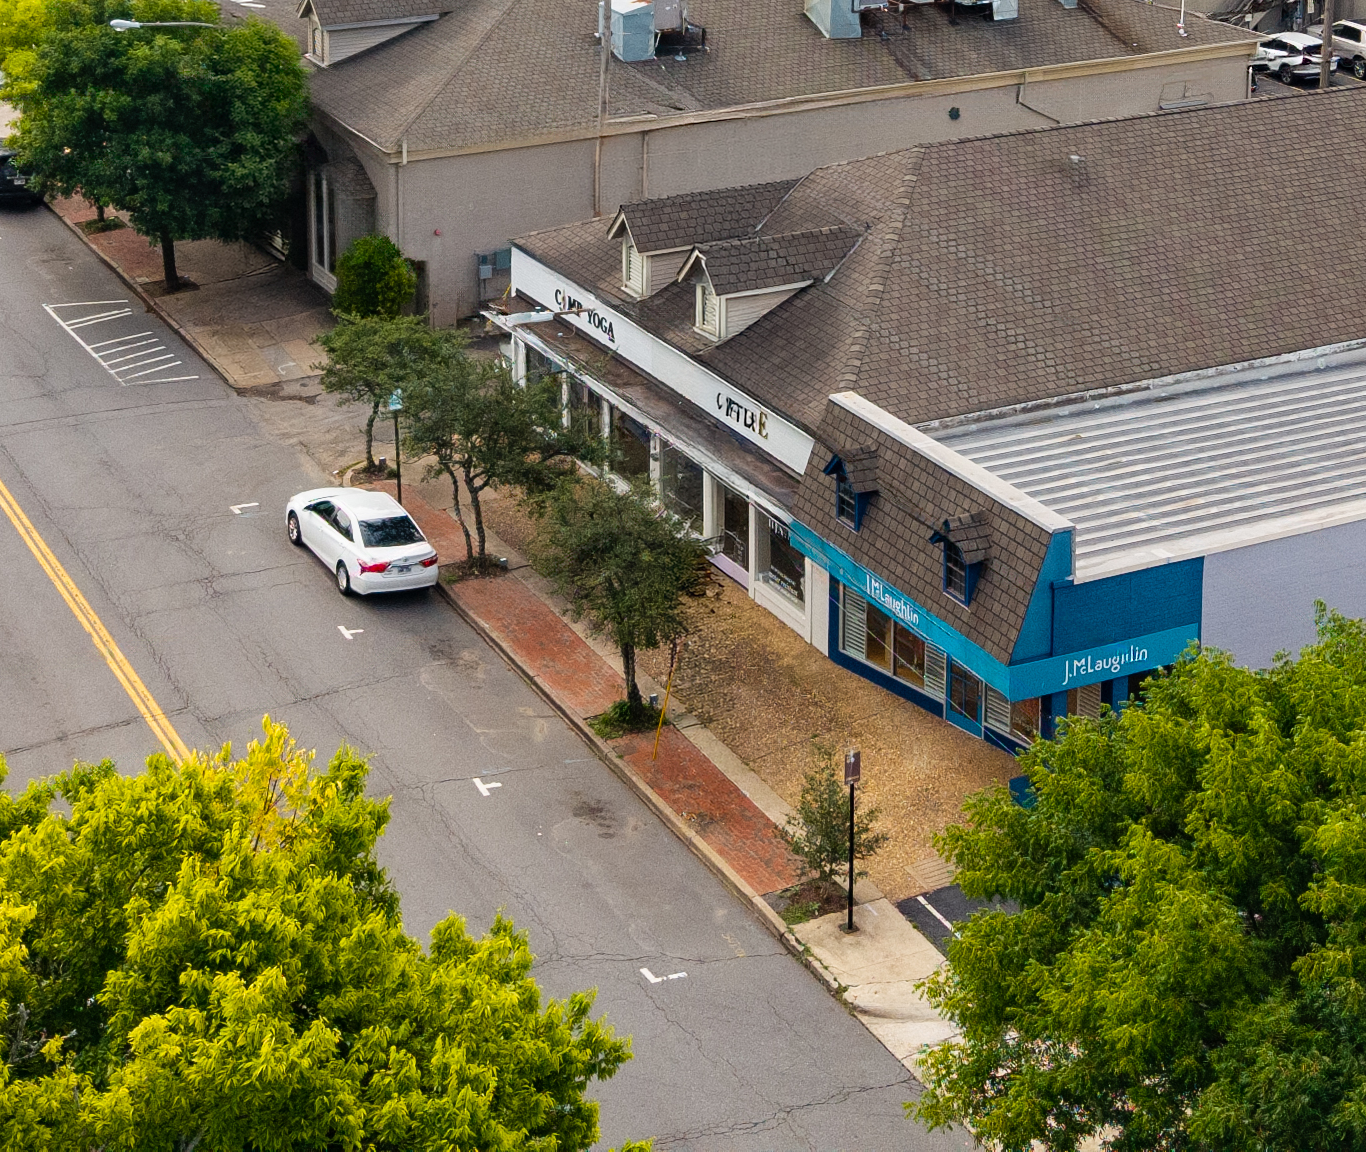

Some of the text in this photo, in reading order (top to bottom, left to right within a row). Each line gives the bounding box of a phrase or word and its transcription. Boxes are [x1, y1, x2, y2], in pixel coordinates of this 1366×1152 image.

[554, 288, 616, 344] CMP YOGA
[866, 573, 919, 626] JMcLaughlin
